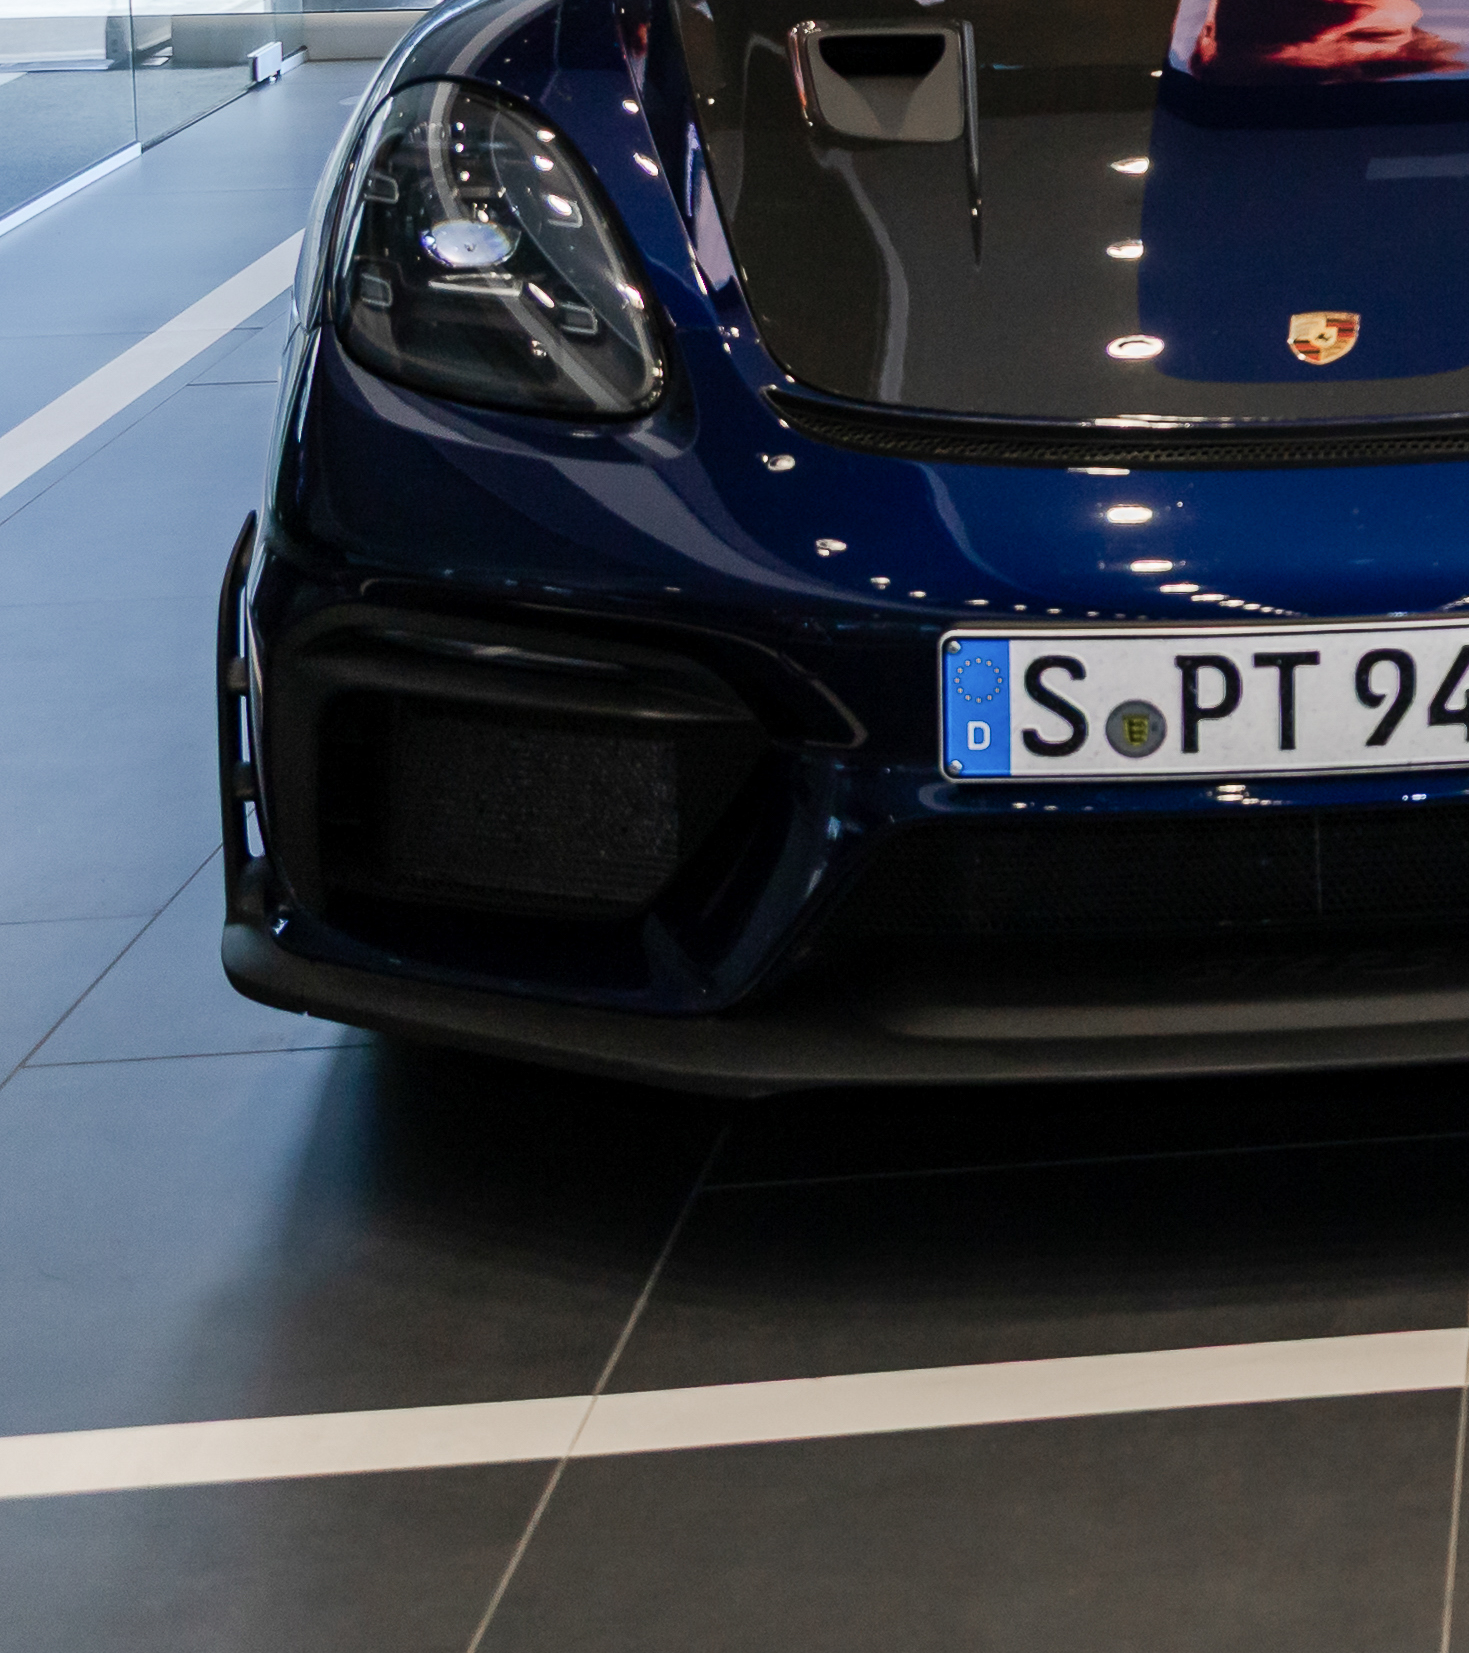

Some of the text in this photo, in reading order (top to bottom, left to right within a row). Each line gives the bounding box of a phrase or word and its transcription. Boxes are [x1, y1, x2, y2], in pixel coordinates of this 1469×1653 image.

[966, 719, 992, 751] D
[1021, 654, 1090, 757] S
[1174, 649, 1321, 754] PT
